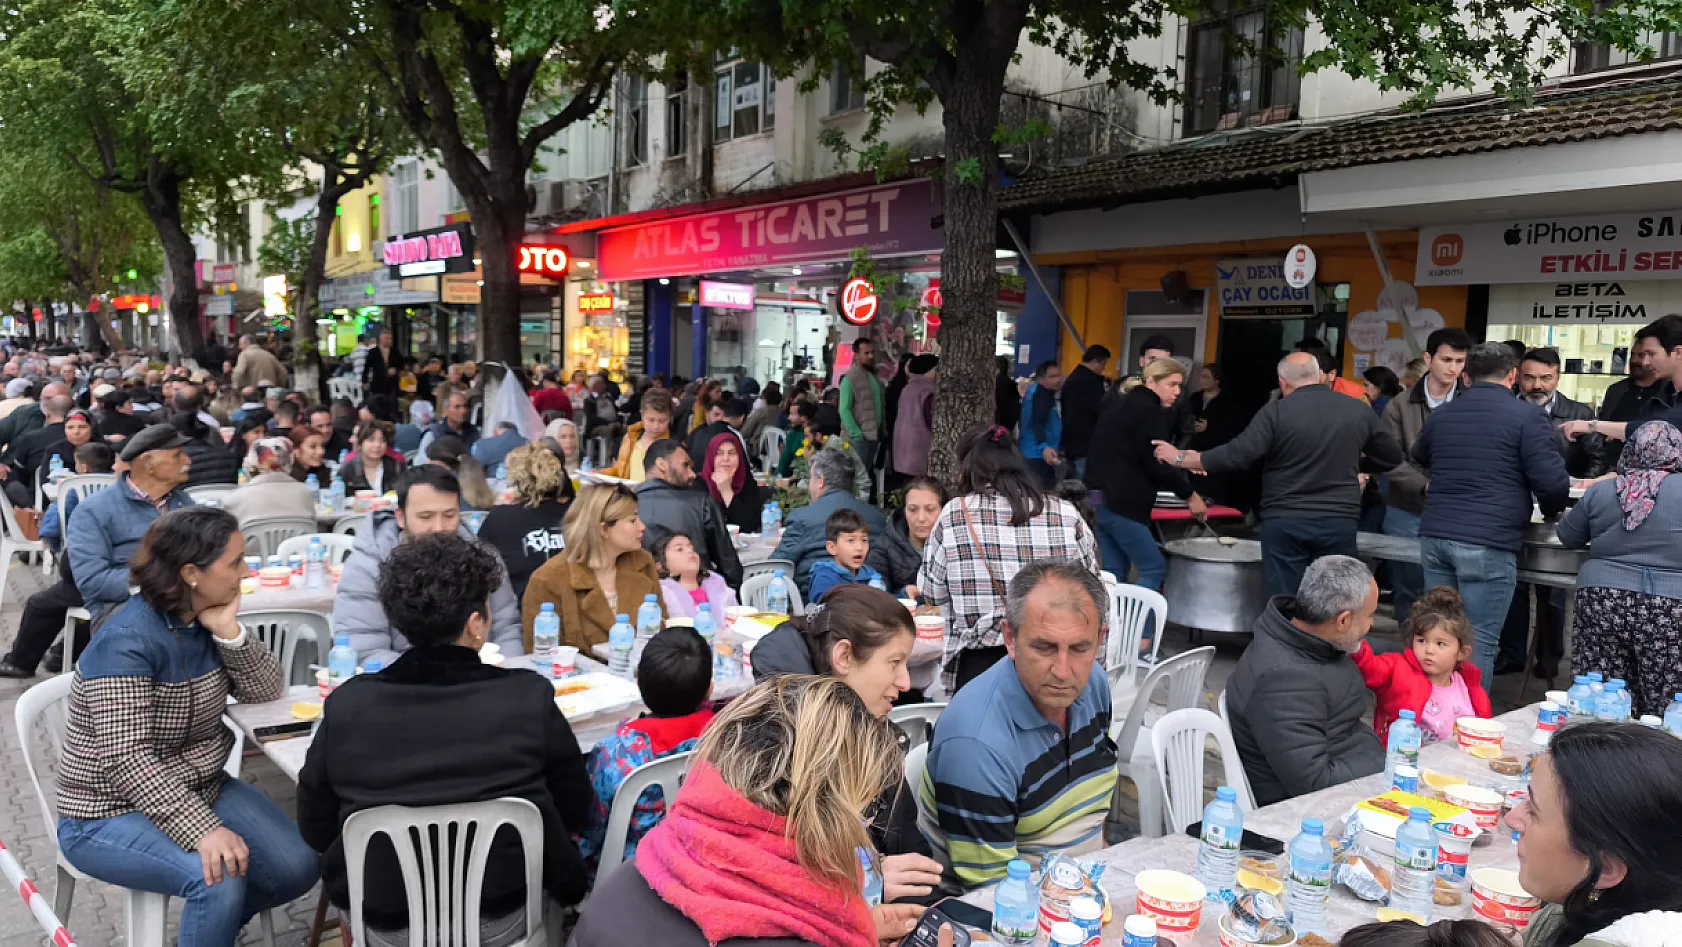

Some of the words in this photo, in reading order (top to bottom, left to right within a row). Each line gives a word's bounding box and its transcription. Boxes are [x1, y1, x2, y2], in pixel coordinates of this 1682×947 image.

[633, 217, 721, 260] ATLAS
[735, 188, 900, 248] TİCARET
[1527, 222, 1617, 245] iPhone
[1638, 217, 1682, 237] SA
[1247, 261, 1285, 280] DENİ
[1540, 248, 1627, 273] ETKİLİ
[1428, 268, 1464, 277] xiaomi
[1223, 287, 1252, 304] ÇAY
[1555, 282, 1626, 297] BETA
[1532, 301, 1647, 322] İLETİŞİM
